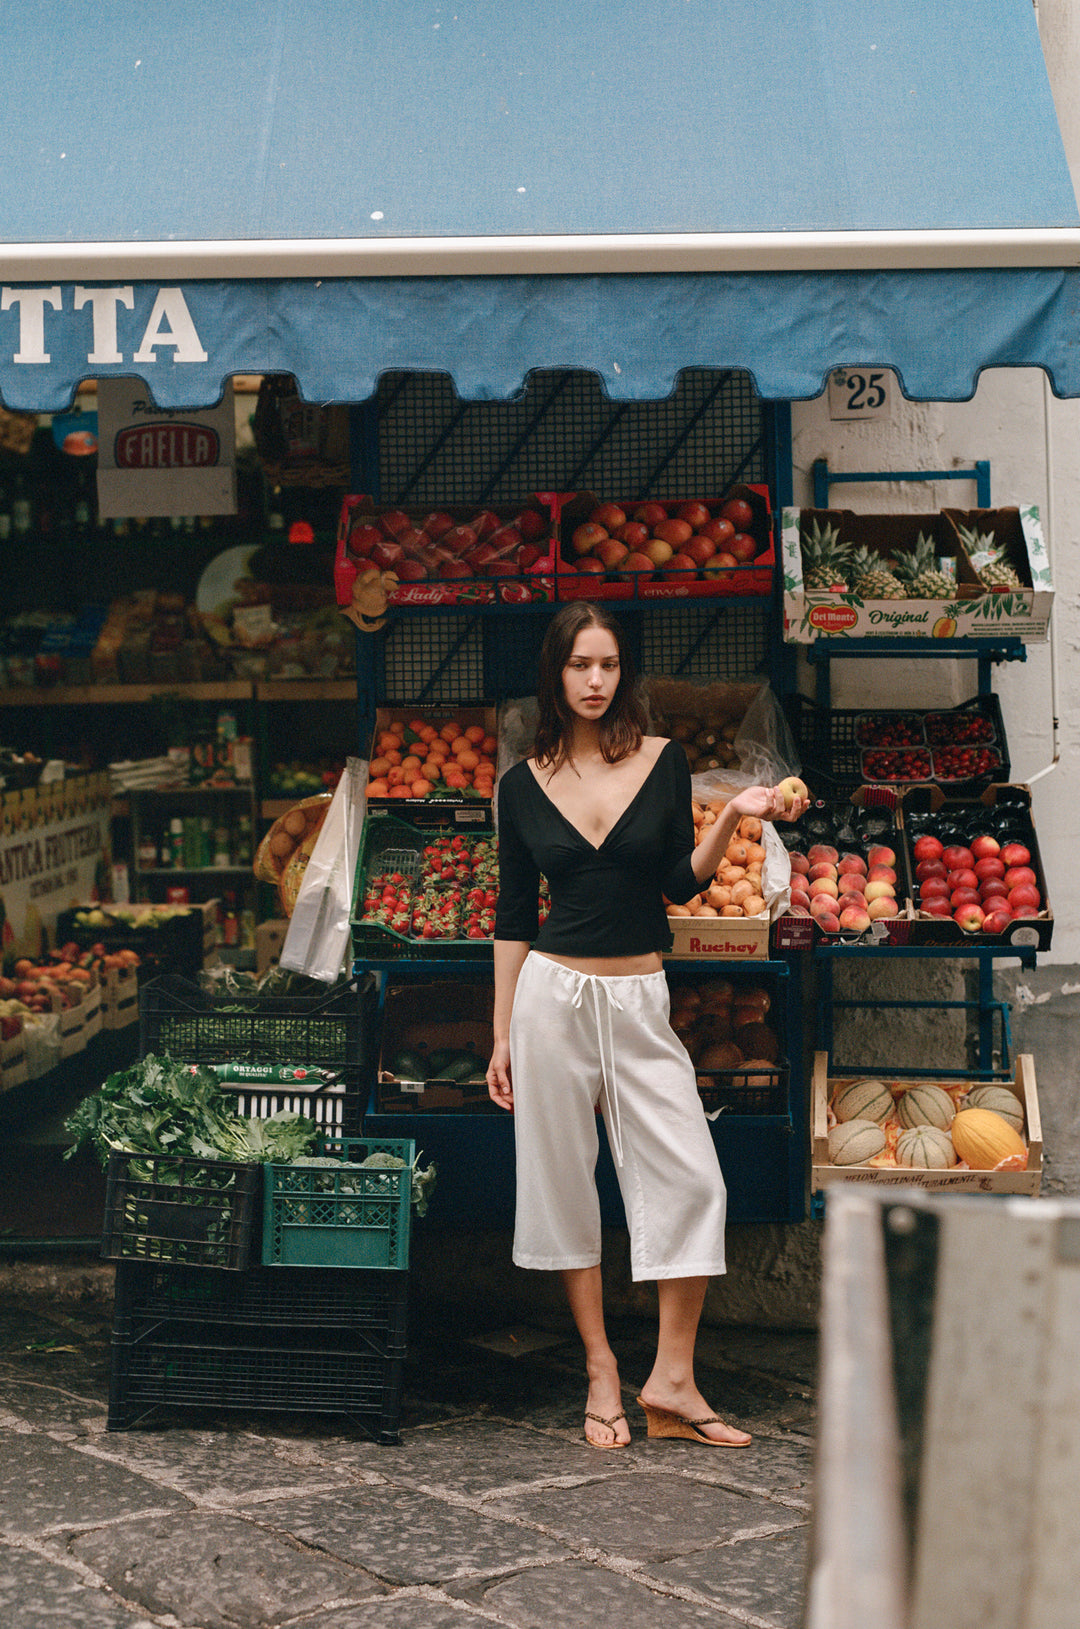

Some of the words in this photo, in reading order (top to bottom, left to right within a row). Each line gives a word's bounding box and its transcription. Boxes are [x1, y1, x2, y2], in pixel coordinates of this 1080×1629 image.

[1, 286, 208, 364] TTA
[847, 374, 886, 410] 25
[125, 430, 209, 467] FAELLA
[402, 587, 445, 604] Lady
[812, 612, 826, 621] Del
[827, 612, 855, 622] Monte
[868, 610, 929, 628] Original
[232, 1065, 273, 1074] ORTAGGI
[844, 1172, 879, 1183] MELONI
